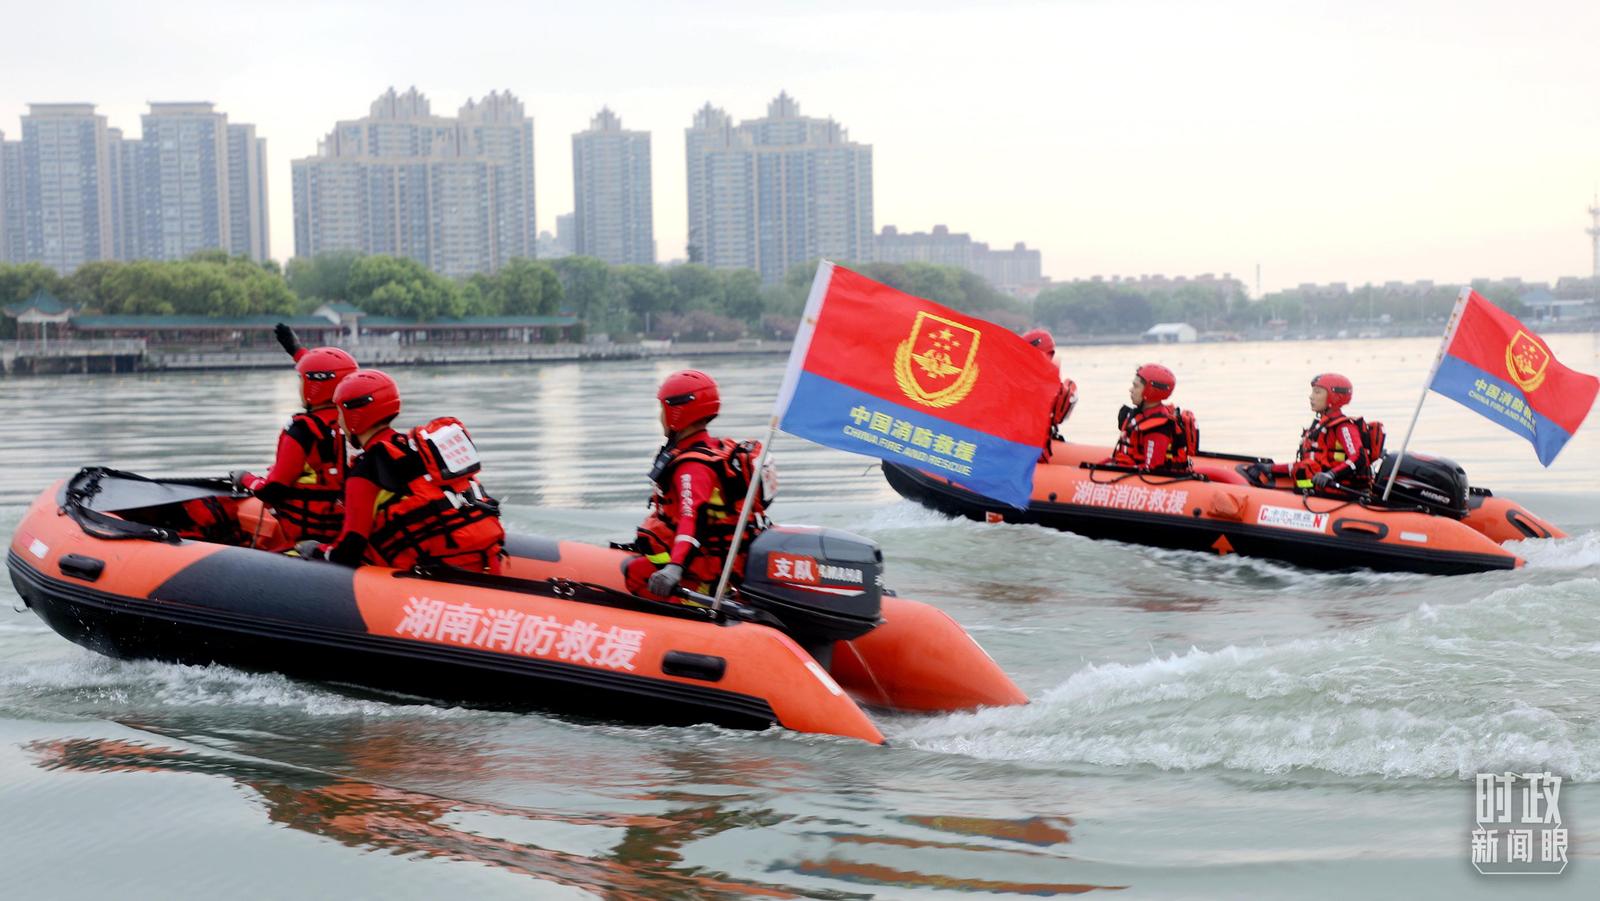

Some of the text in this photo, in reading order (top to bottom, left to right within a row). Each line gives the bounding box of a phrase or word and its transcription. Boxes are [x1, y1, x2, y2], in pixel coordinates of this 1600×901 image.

[843, 425, 974, 476] CHINA FIRE AND RESCUE
[850, 405, 977, 462] 中国消防救援
[1072, 481, 1188, 514] 湖南消防救援
[773, 557, 815, 582] 支队
[395, 596, 646, 671] 湖南消防救援
